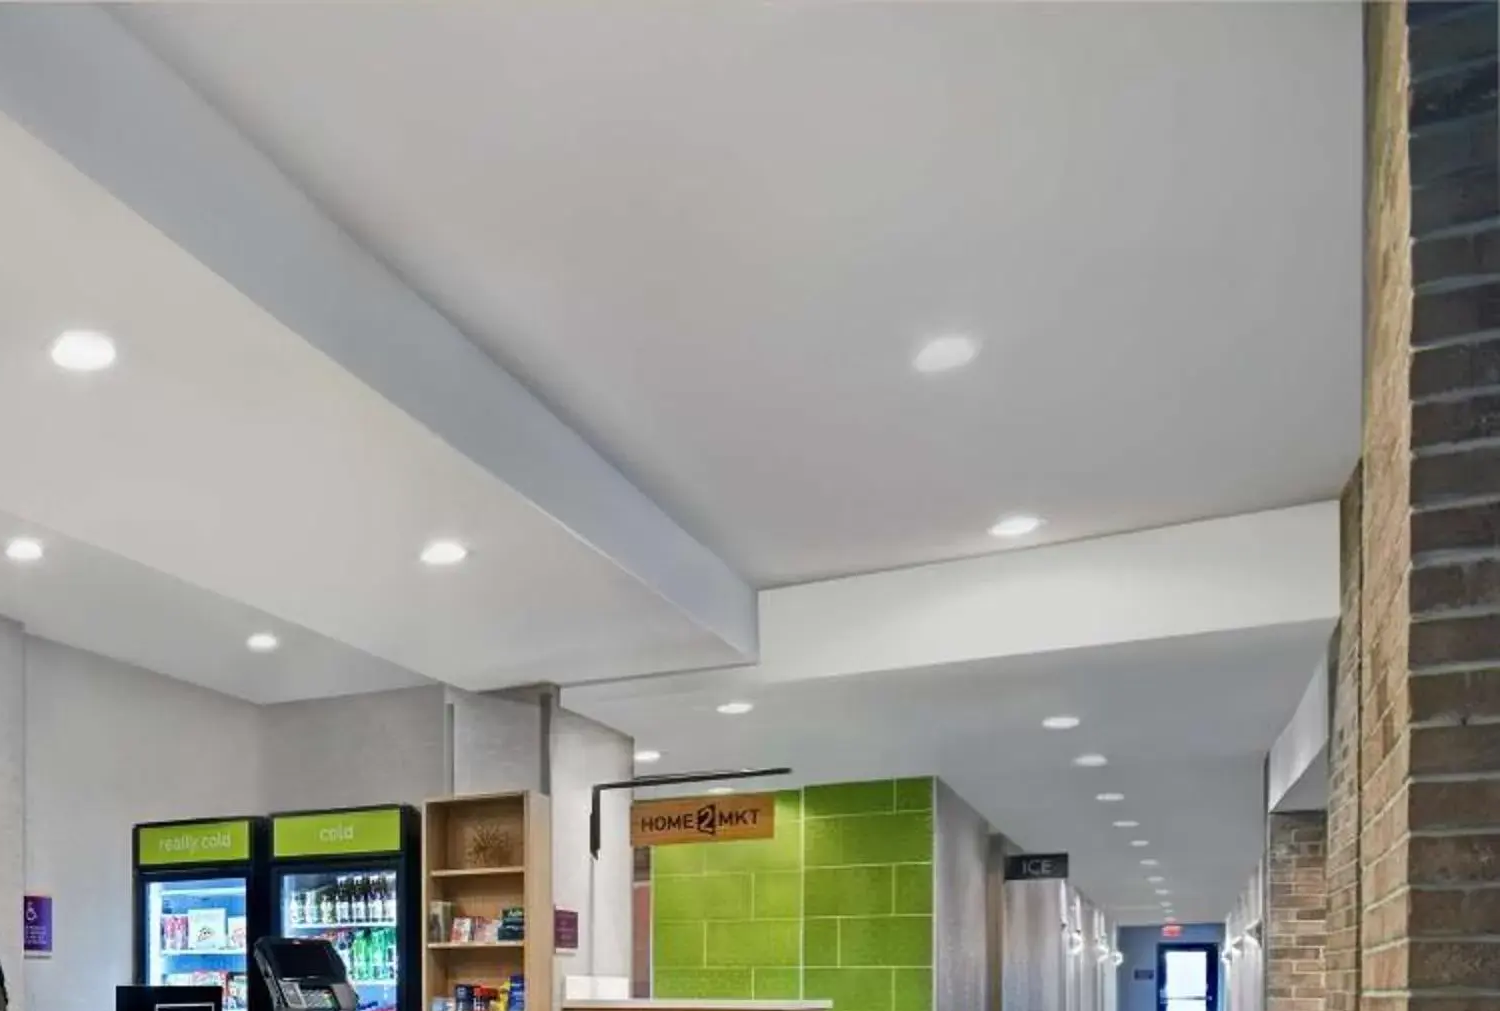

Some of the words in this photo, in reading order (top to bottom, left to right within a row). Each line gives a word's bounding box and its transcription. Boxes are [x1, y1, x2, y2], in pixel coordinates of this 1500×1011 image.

[319, 825, 354, 842] cold
[159, 834, 199, 856] really
[201, 831, 231, 849] cold
[1022, 859, 1053, 875] ICE
